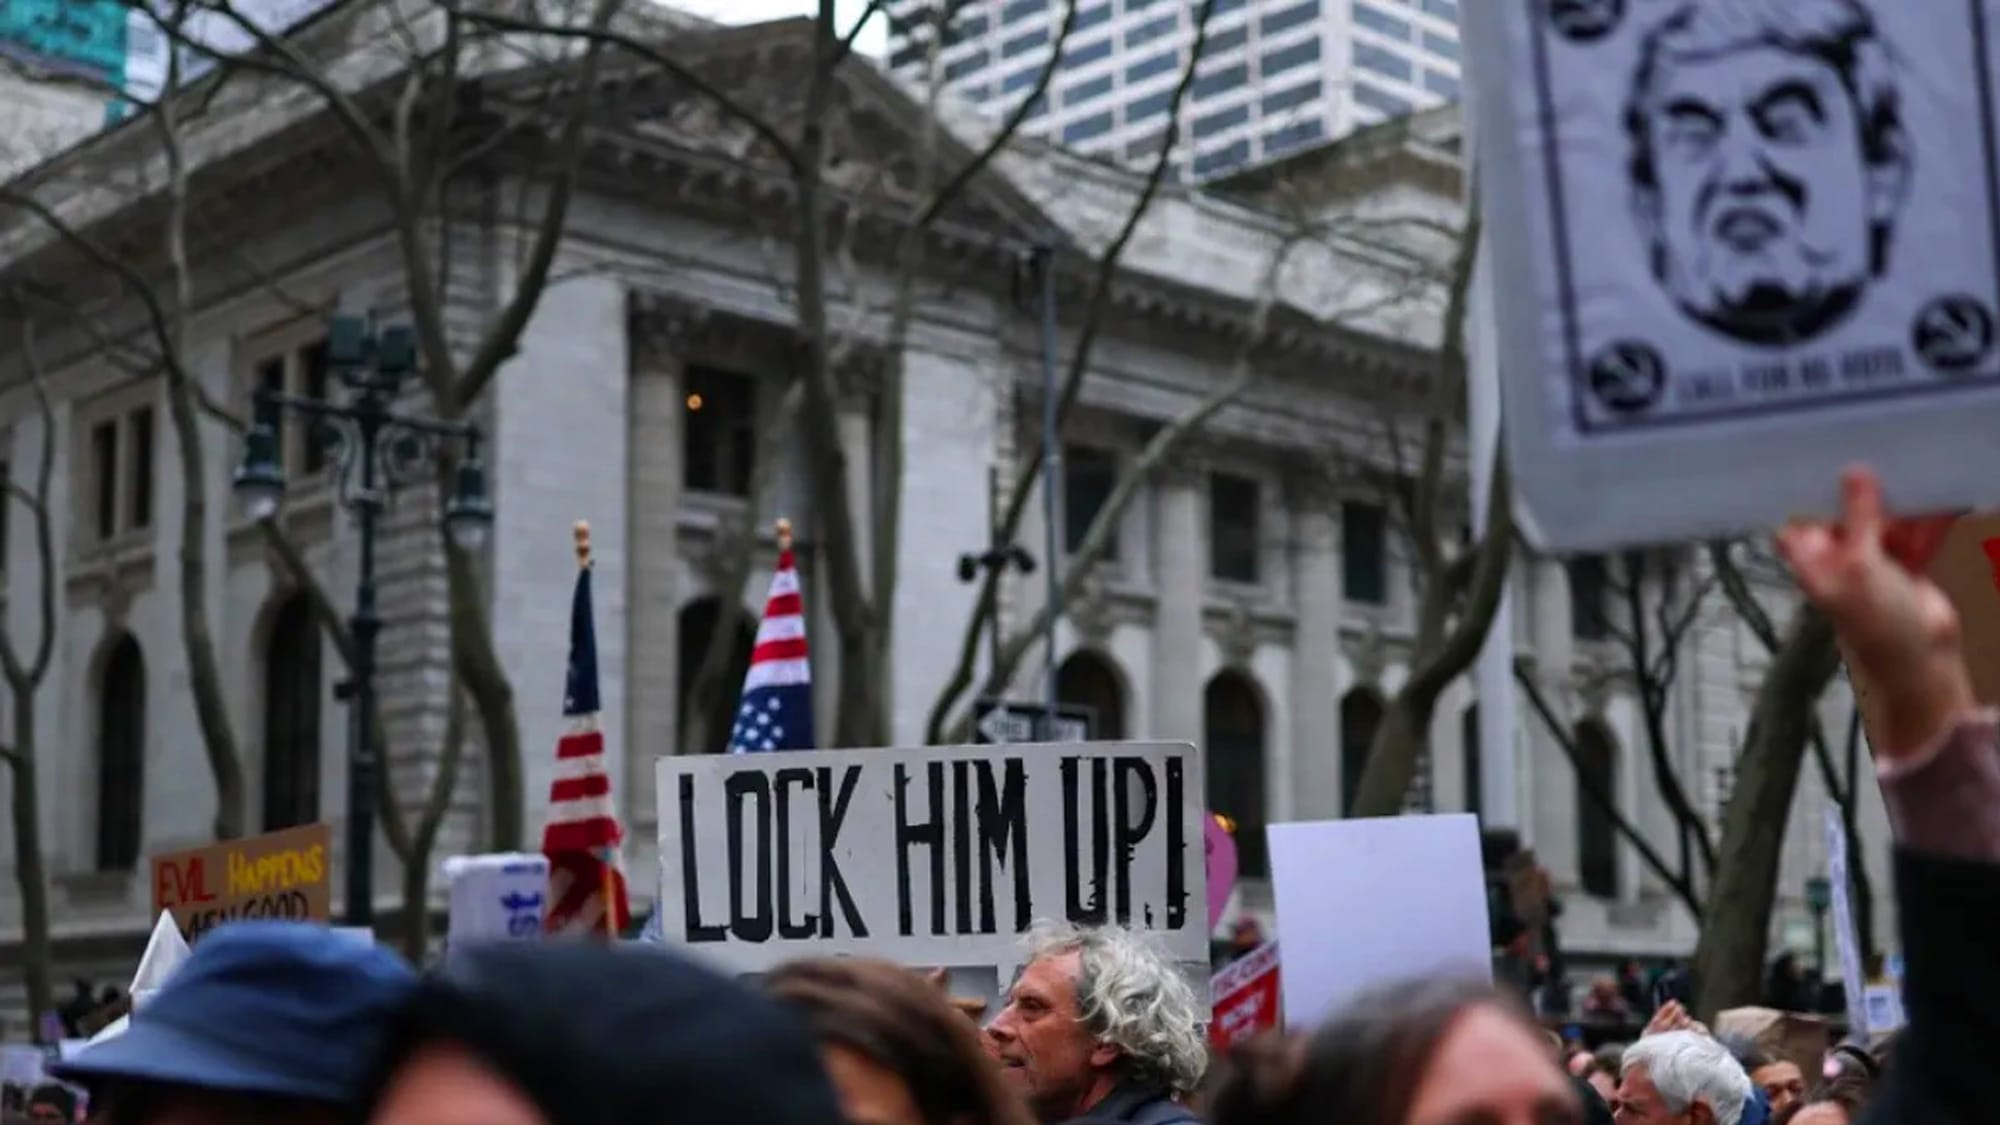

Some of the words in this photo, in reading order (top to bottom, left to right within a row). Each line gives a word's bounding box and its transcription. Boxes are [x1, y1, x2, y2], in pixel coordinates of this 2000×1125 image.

[157, 856, 216, 908] EVIL
[227, 844, 324, 897] HAPPENS
[679, 765, 869, 942] LOCK
[894, 757, 1032, 936] HIM
[1061, 756, 1191, 930] UP!
